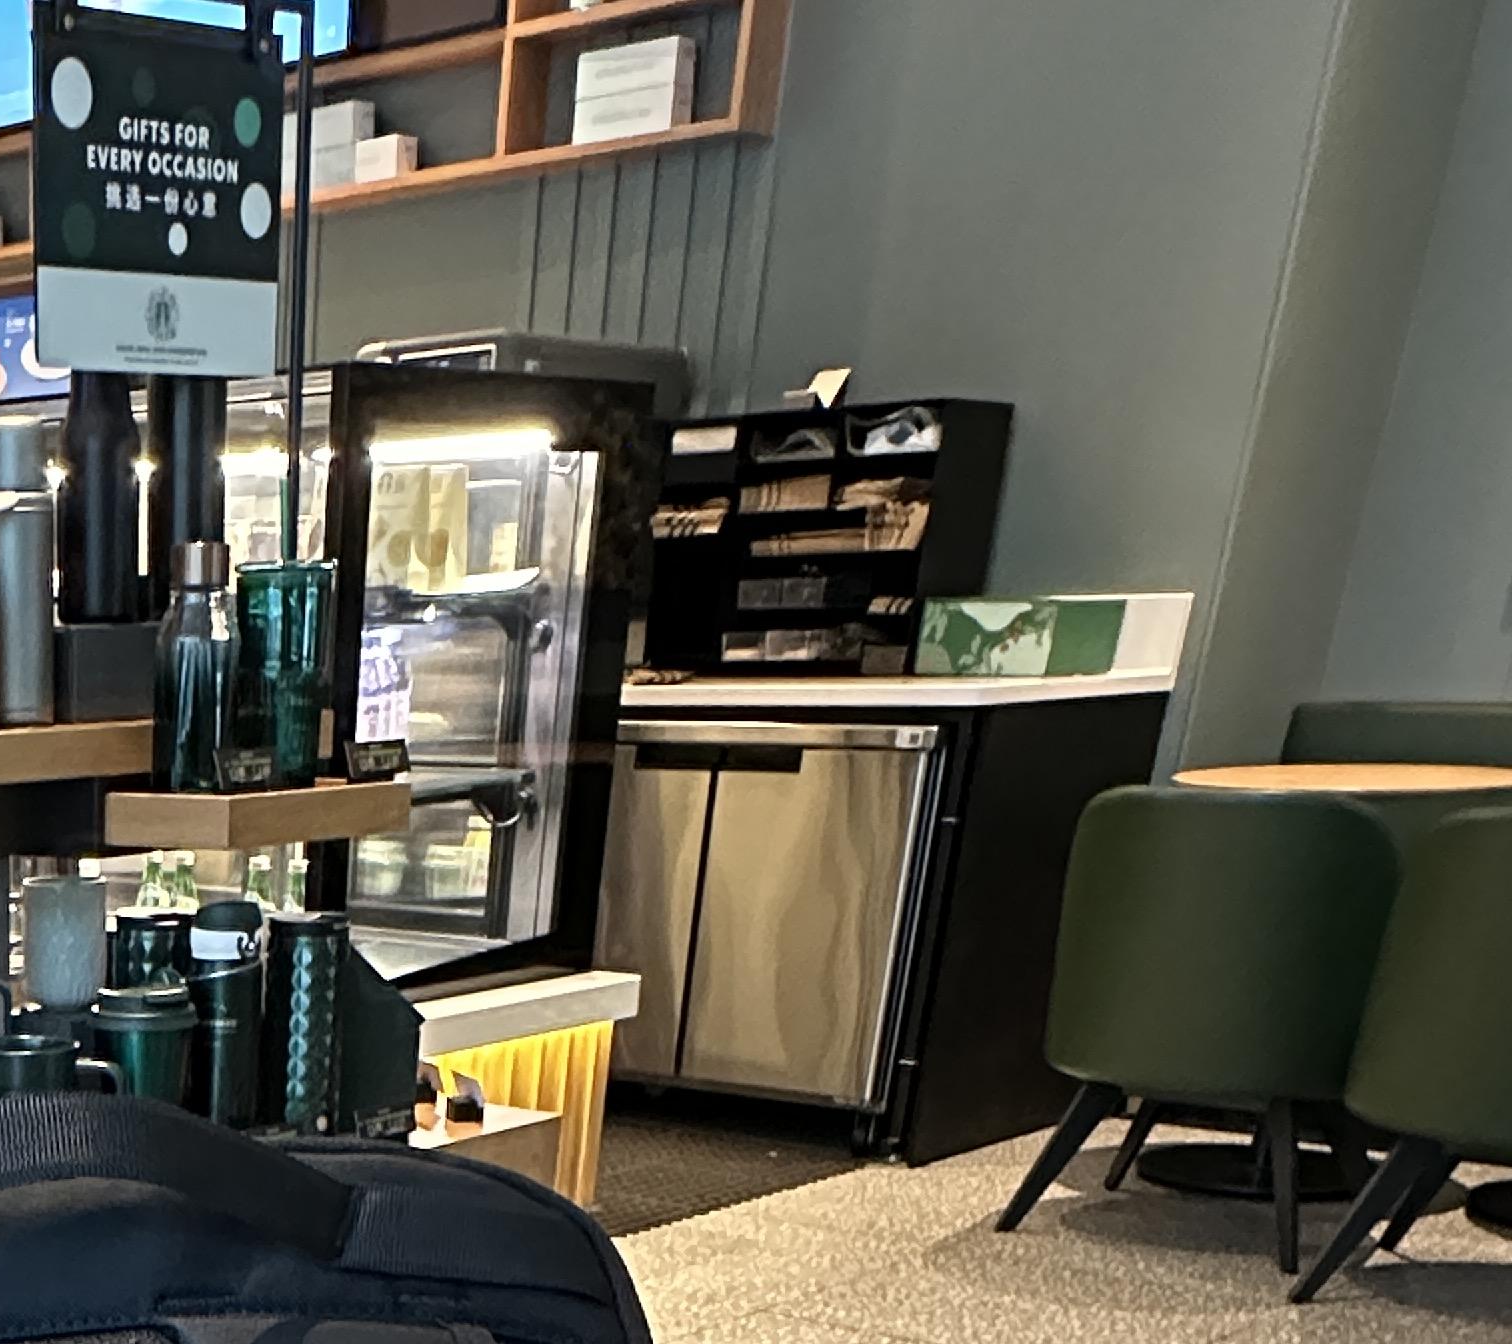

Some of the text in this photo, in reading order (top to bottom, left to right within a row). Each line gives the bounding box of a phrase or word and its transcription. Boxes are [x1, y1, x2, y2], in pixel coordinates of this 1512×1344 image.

[118, 116, 210, 150] GIFTS FOR
[86, 144, 240, 184] EVERY OCCASION
